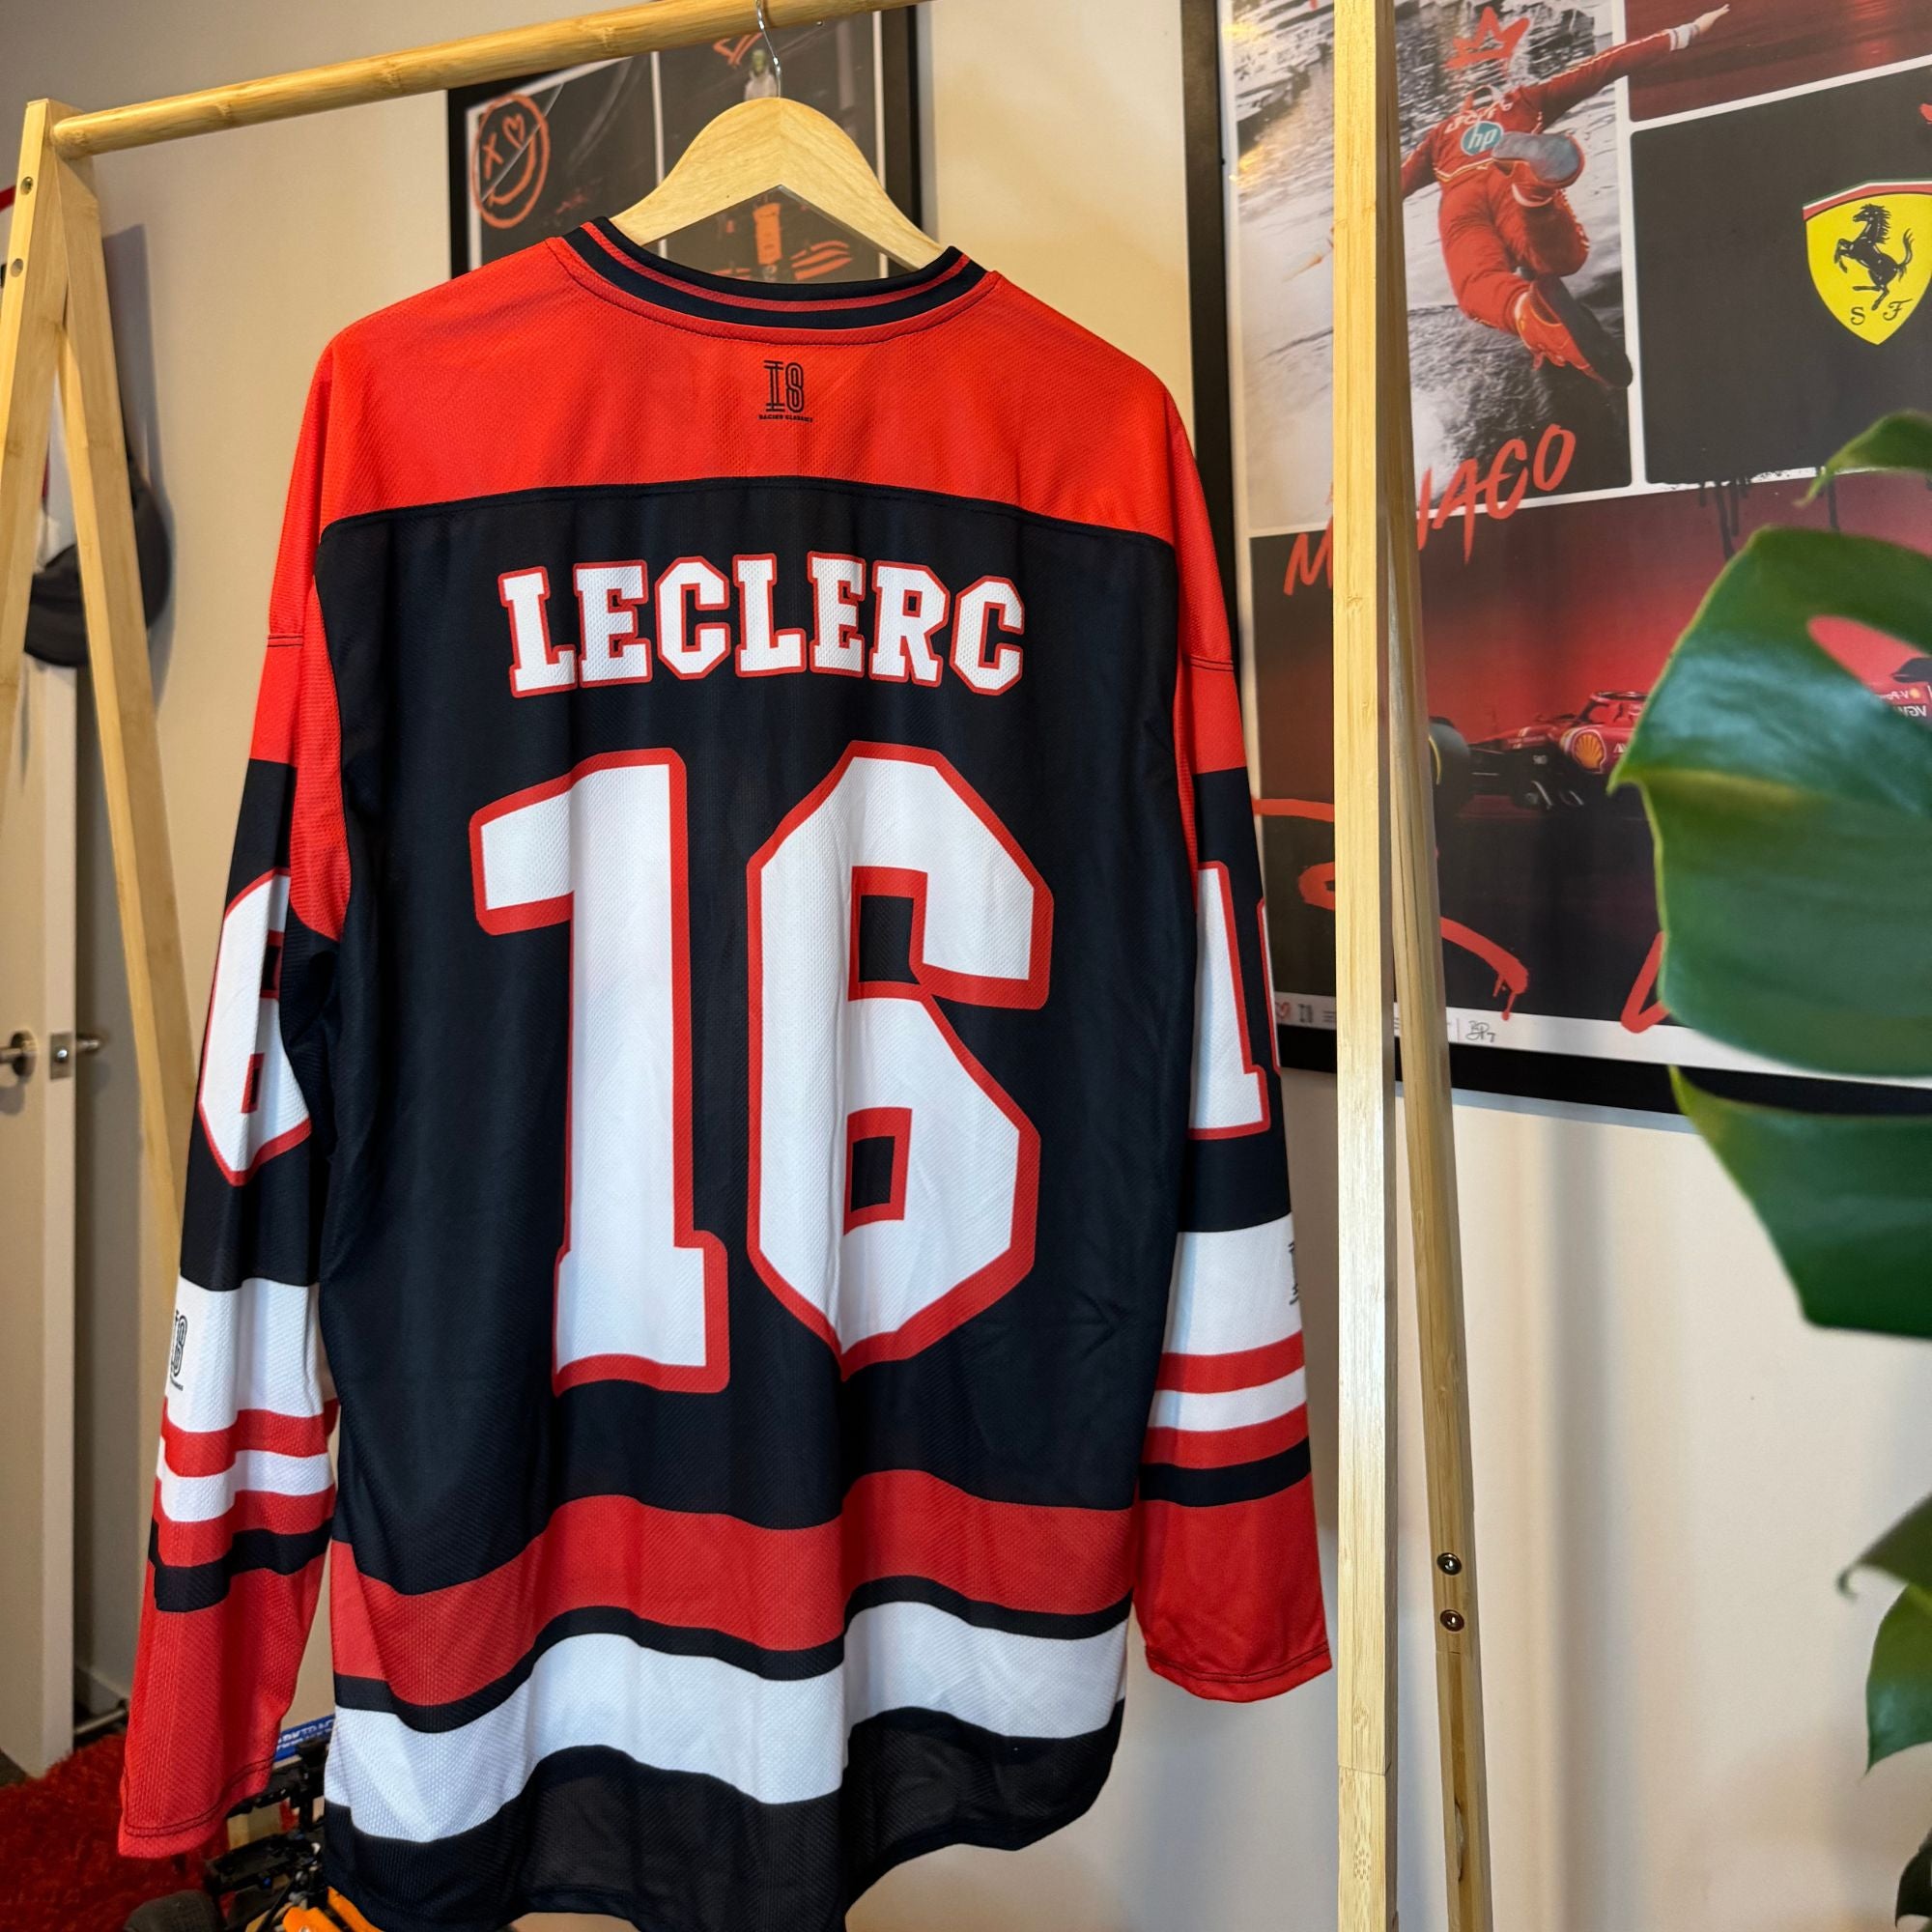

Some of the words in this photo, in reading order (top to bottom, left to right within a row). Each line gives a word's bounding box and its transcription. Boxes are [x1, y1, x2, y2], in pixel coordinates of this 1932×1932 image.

[1467, 123, 1497, 153] hp
[1850, 305, 1866, 327] S
[1882, 298, 1914, 322] F
[498, 551, 1025, 698] LECLERC
[469, 740, 1054, 1397] 16
